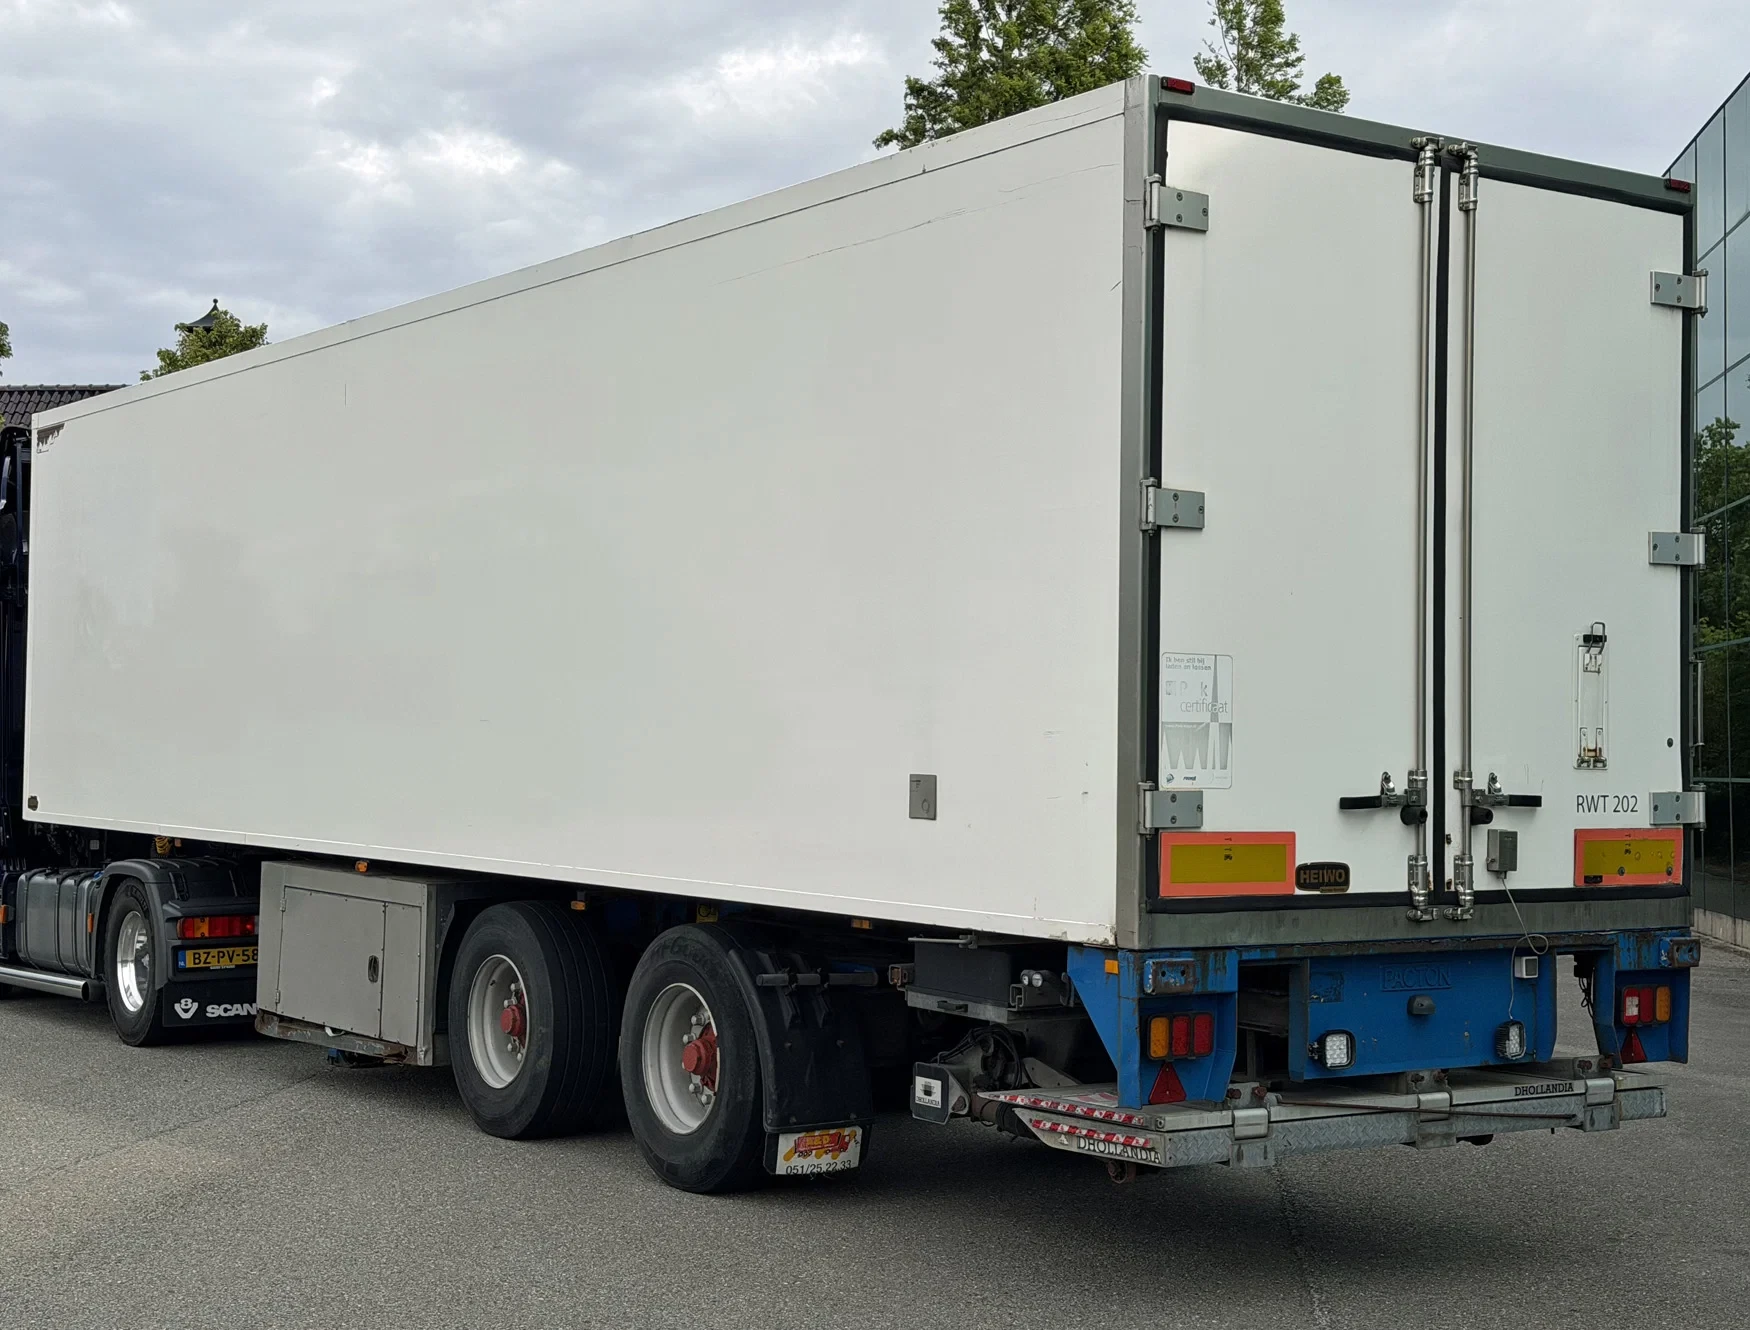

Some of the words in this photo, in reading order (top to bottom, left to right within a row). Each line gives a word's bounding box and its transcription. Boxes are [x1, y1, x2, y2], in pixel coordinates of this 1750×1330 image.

[1180, 697, 1228, 713] certificaat
[1576, 795, 1609, 813] RWT
[1612, 795, 1638, 813] 202
[1299, 869, 1346, 883] HEIWO
[192, 948, 259, 966] BZ-PV-58
[1383, 967, 1451, 989] PACTON
[1514, 1082, 1574, 1096] DHOLLANDIA
[1076, 1136, 1161, 1165] DHOLLANDIA
